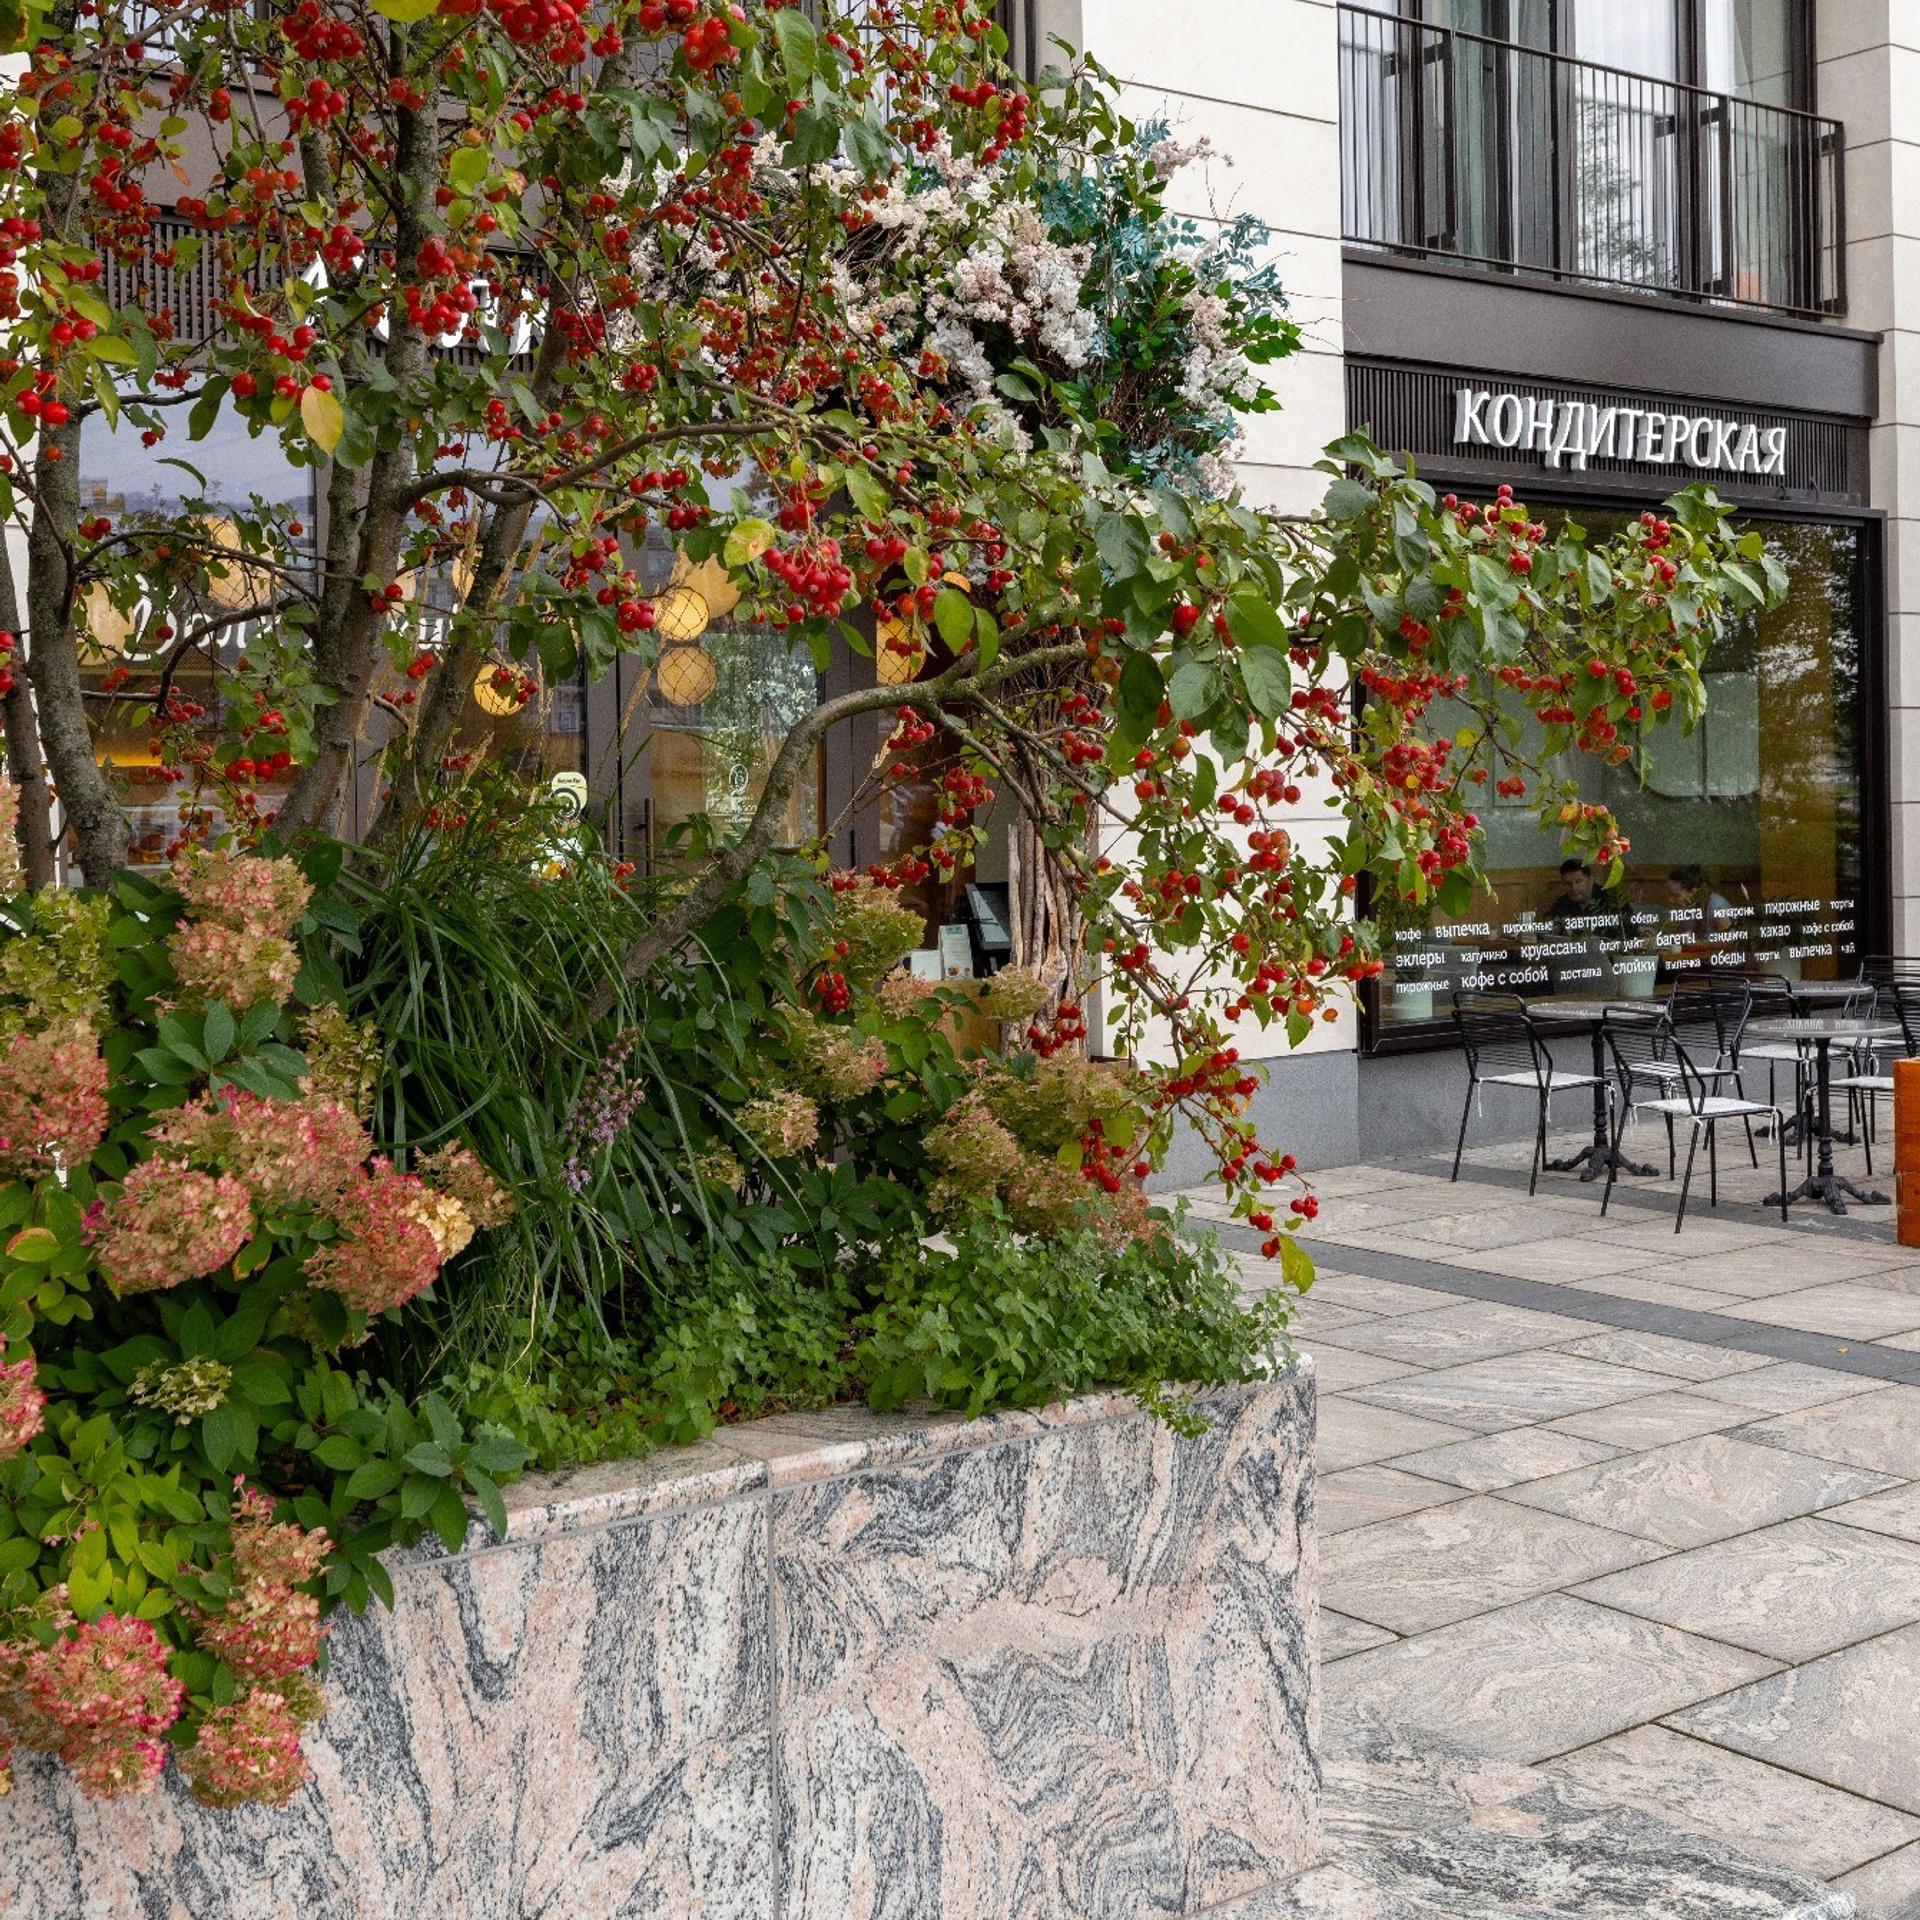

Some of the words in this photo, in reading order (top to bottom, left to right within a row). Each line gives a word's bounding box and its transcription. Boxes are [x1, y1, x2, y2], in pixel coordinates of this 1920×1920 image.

[1453, 388, 1787, 476] КОНДИТЕРСКАЯ
[1396, 928, 1421, 942] кофе
[1436, 922, 1490, 938] выпечка
[1503, 921, 1553, 934] пирожные
[1565, 914, 1619, 931] завтраки
[1670, 908, 1703, 921] паста
[1765, 899, 1820, 915] пирожные
[1830, 899, 1854, 911] торты
[1396, 952, 1445, 969] эклеры
[1461, 950, 1508, 964] капучино
[1520, 941, 1587, 960] круассаны
[1599, 940, 1621, 954] флэт
[1623, 938, 1644, 953] уайт
[1656, 931, 1696, 947] багеты
[1760, 925, 1791, 938] какао
[1802, 923, 1823, 935] кофе
[1824, 924, 1830, 932] с
[1831, 920, 1854, 933] собой
[1396, 979, 1450, 994] пирожные
[1461, 971, 1495, 990] кофе
[1498, 973, 1505, 985] с
[1509, 966, 1549, 983] собой
[1560, 967, 1602, 981] доставка
[1613, 958, 1656, 973] слойки
[1665, 957, 1701, 971] выпечка
[1710, 951, 1746, 966] обеды
[1754, 950, 1781, 963] торты
[1789, 943, 1832, 959] выпечка
